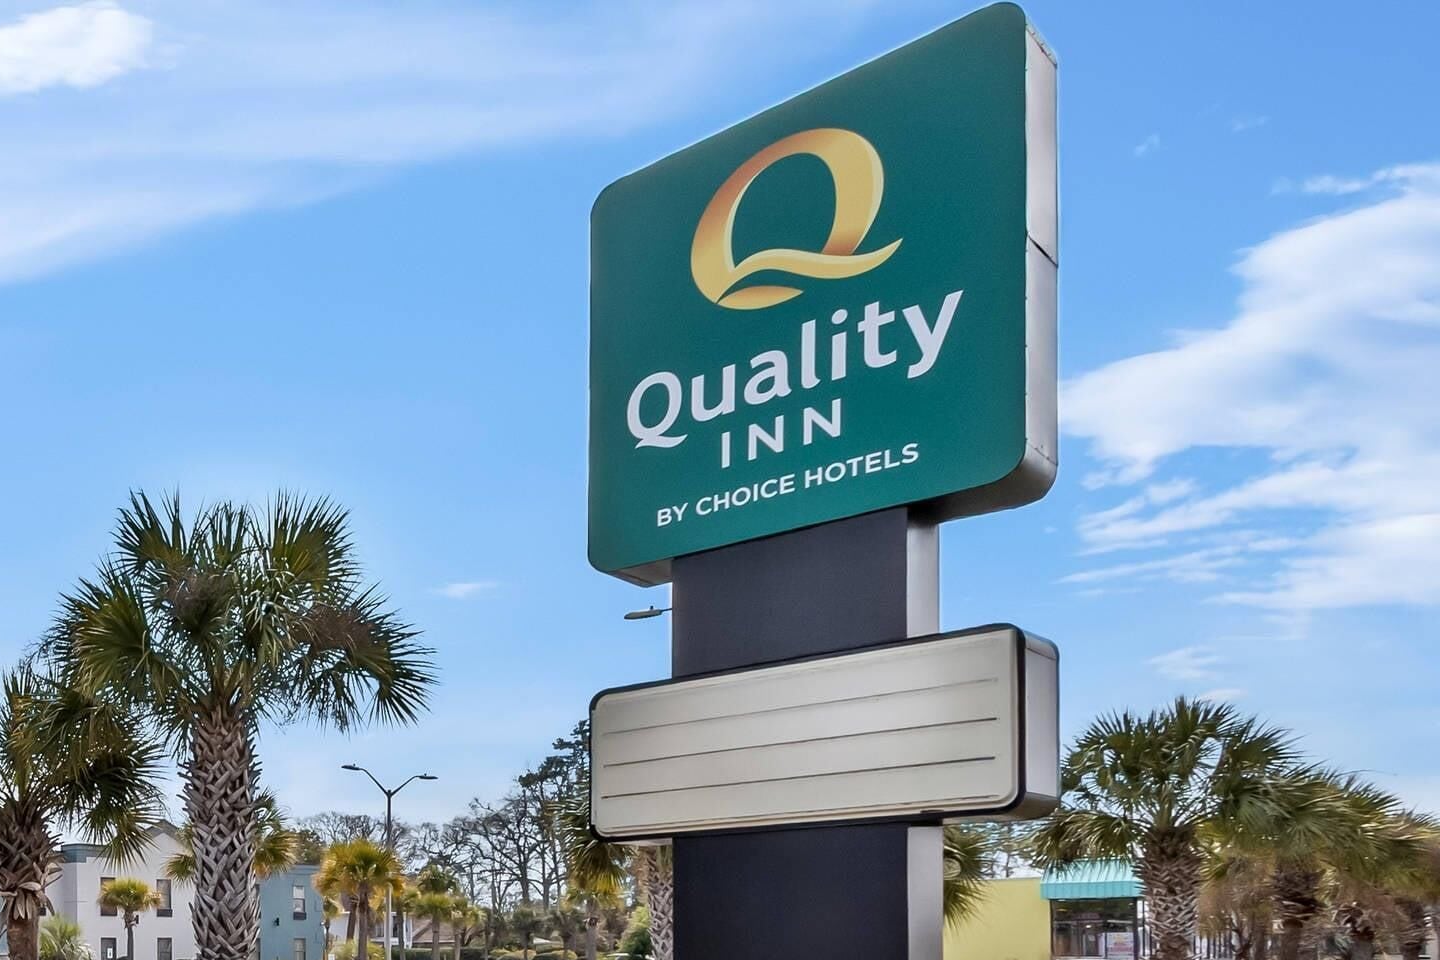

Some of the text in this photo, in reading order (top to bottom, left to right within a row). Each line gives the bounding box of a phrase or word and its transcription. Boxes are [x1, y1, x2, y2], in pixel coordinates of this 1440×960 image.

[626, 289, 964, 449] Quality
[721, 398, 842, 469] INN
[657, 443, 920, 527] BY CHOICE HOTELS
